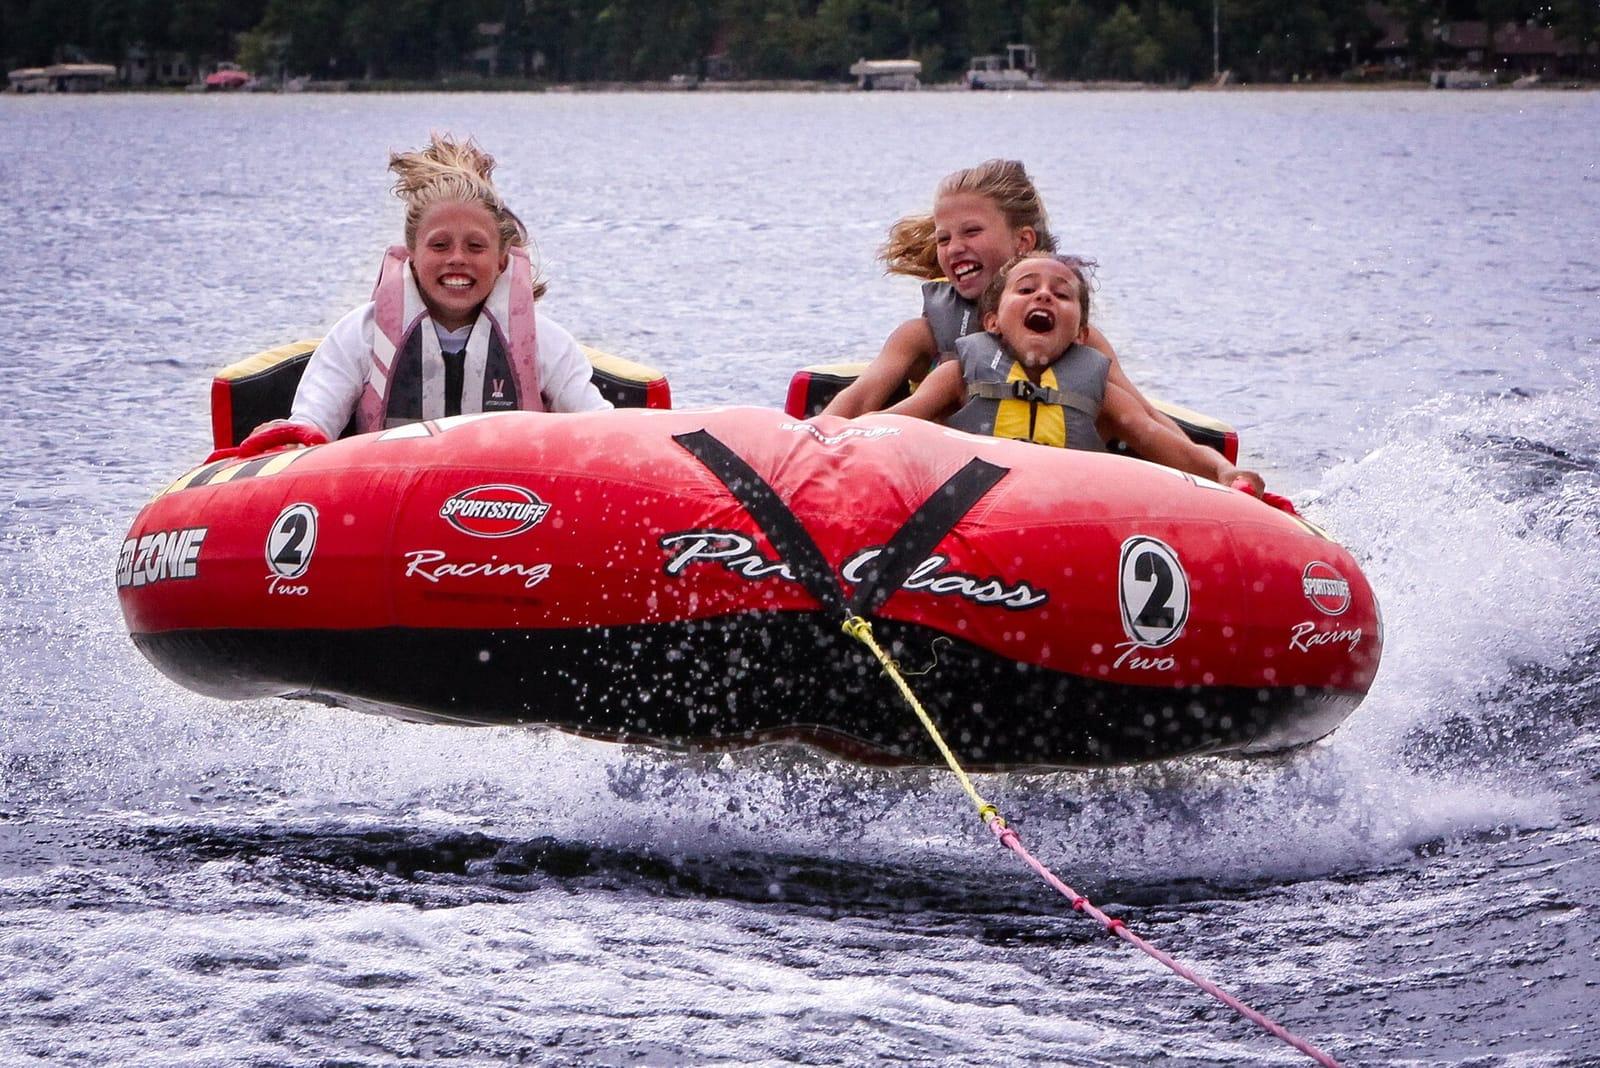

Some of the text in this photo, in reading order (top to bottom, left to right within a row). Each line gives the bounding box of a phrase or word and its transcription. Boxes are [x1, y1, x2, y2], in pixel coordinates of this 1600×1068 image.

[441, 498, 548, 522] SPORTSSTUFF
[273, 513, 308, 564] 2
[133, 528, 208, 586] ZONE
[404, 549, 553, 588] Racing
[265, 574, 310, 596] Two
[1133, 551, 1175, 628] 2
[1289, 620, 1362, 653] Racing
[1113, 640, 1175, 671] Two
